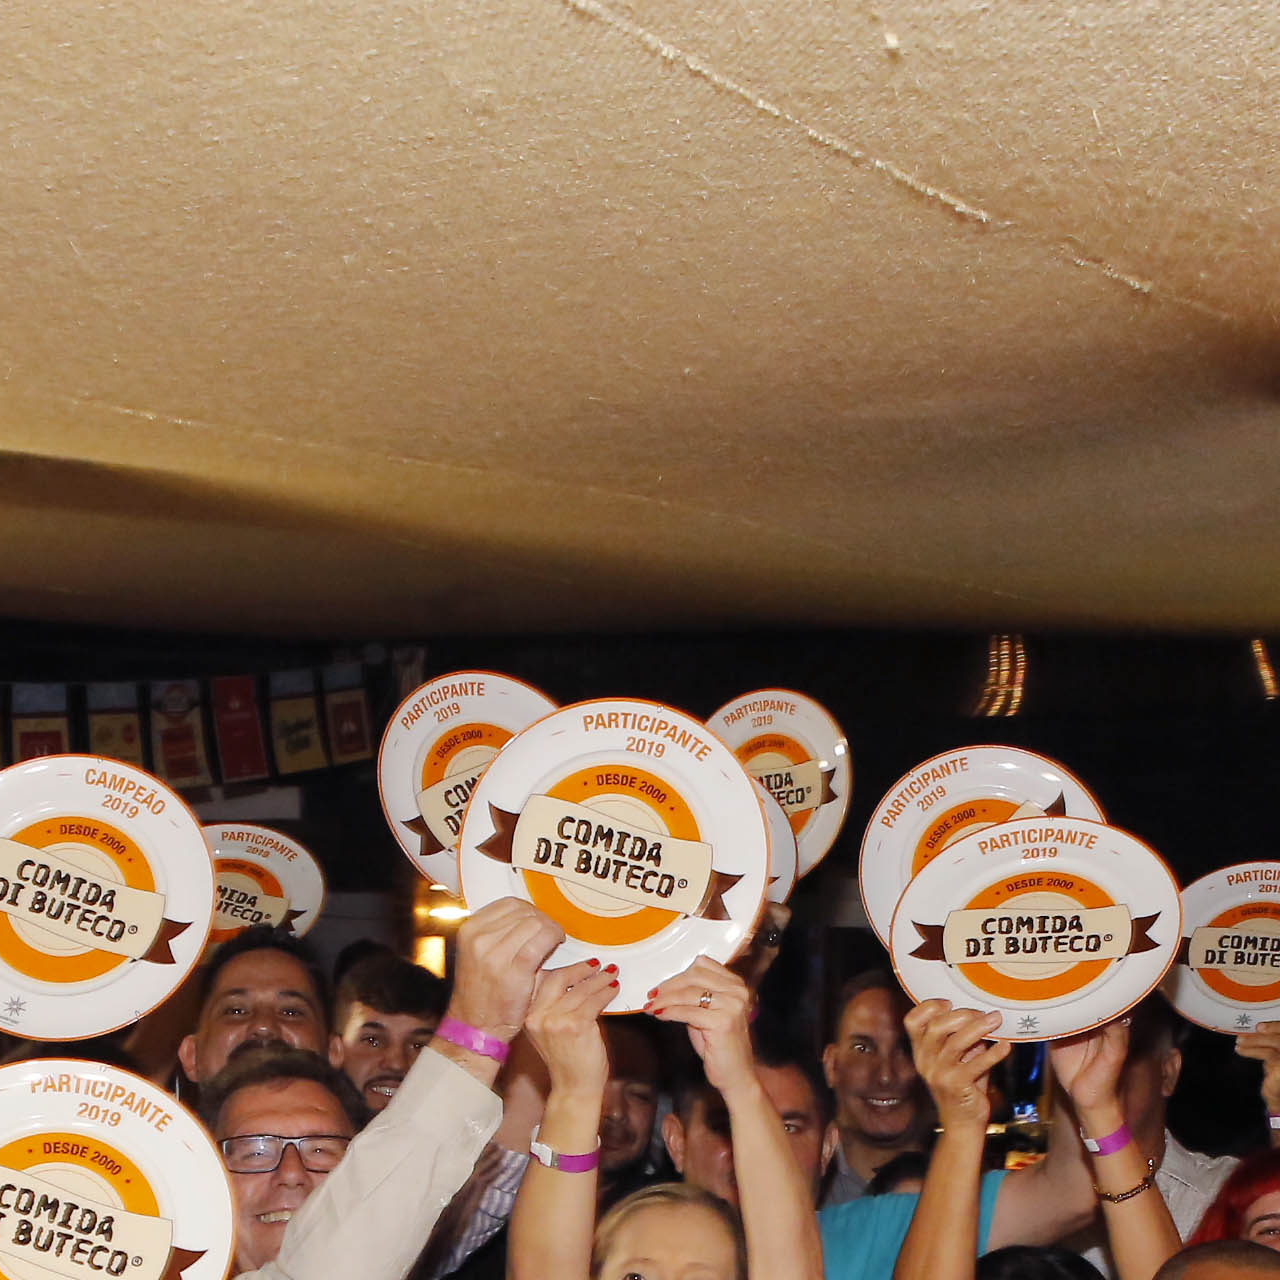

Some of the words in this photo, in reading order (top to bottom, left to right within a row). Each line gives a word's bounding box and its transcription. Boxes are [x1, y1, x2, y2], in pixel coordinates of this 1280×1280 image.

[401, 682, 485, 730] PARTICIPANTE
[433, 702, 461, 723] 2019
[723, 700, 797, 727] PARTICIPANTE
[752, 715, 773, 728] 2019
[437, 737, 461, 758] DESDE
[583, 712, 712, 762] PARTICIPANTE
[626, 736, 665, 758] 2019
[85, 768, 166, 816] CAMPEÃO
[596, 774, 636, 788] DESDE
[639, 781, 667, 804] 2000
[881, 757, 969, 828] PARTICIPANTE
[916, 785, 947, 812] 2019
[101, 794, 139, 819] 2019
[60, 824, 98, 840] DESDE
[102, 834, 126, 855] 2000
[557, 816, 663, 867] COMIDA
[925, 820, 953, 849] DESDE
[952, 808, 976, 825] 2000
[978, 828, 1098, 855] PARTICIPANTE
[221, 832, 298, 862] PARTICIPANTE
[246, 846, 270, 858] 2019
[534, 838, 569, 868] DI
[1022, 847, 1058, 860] 2019
[16, 859, 117, 912] COMIDA
[216, 885, 258, 907] MIDA
[1006, 878, 1043, 892] DESDE
[1046, 878, 1074, 890] 2000
[981, 915, 1083, 935] COMIDA
[965, 936, 994, 957] DI
[1204, 950, 1225, 964] DI
[30, 1073, 174, 1133] PARTICIPANTE
[77, 1102, 122, 1128] 2019
[43, 1141, 89, 1158] DESDE
[90, 1150, 122, 1176] 2000
